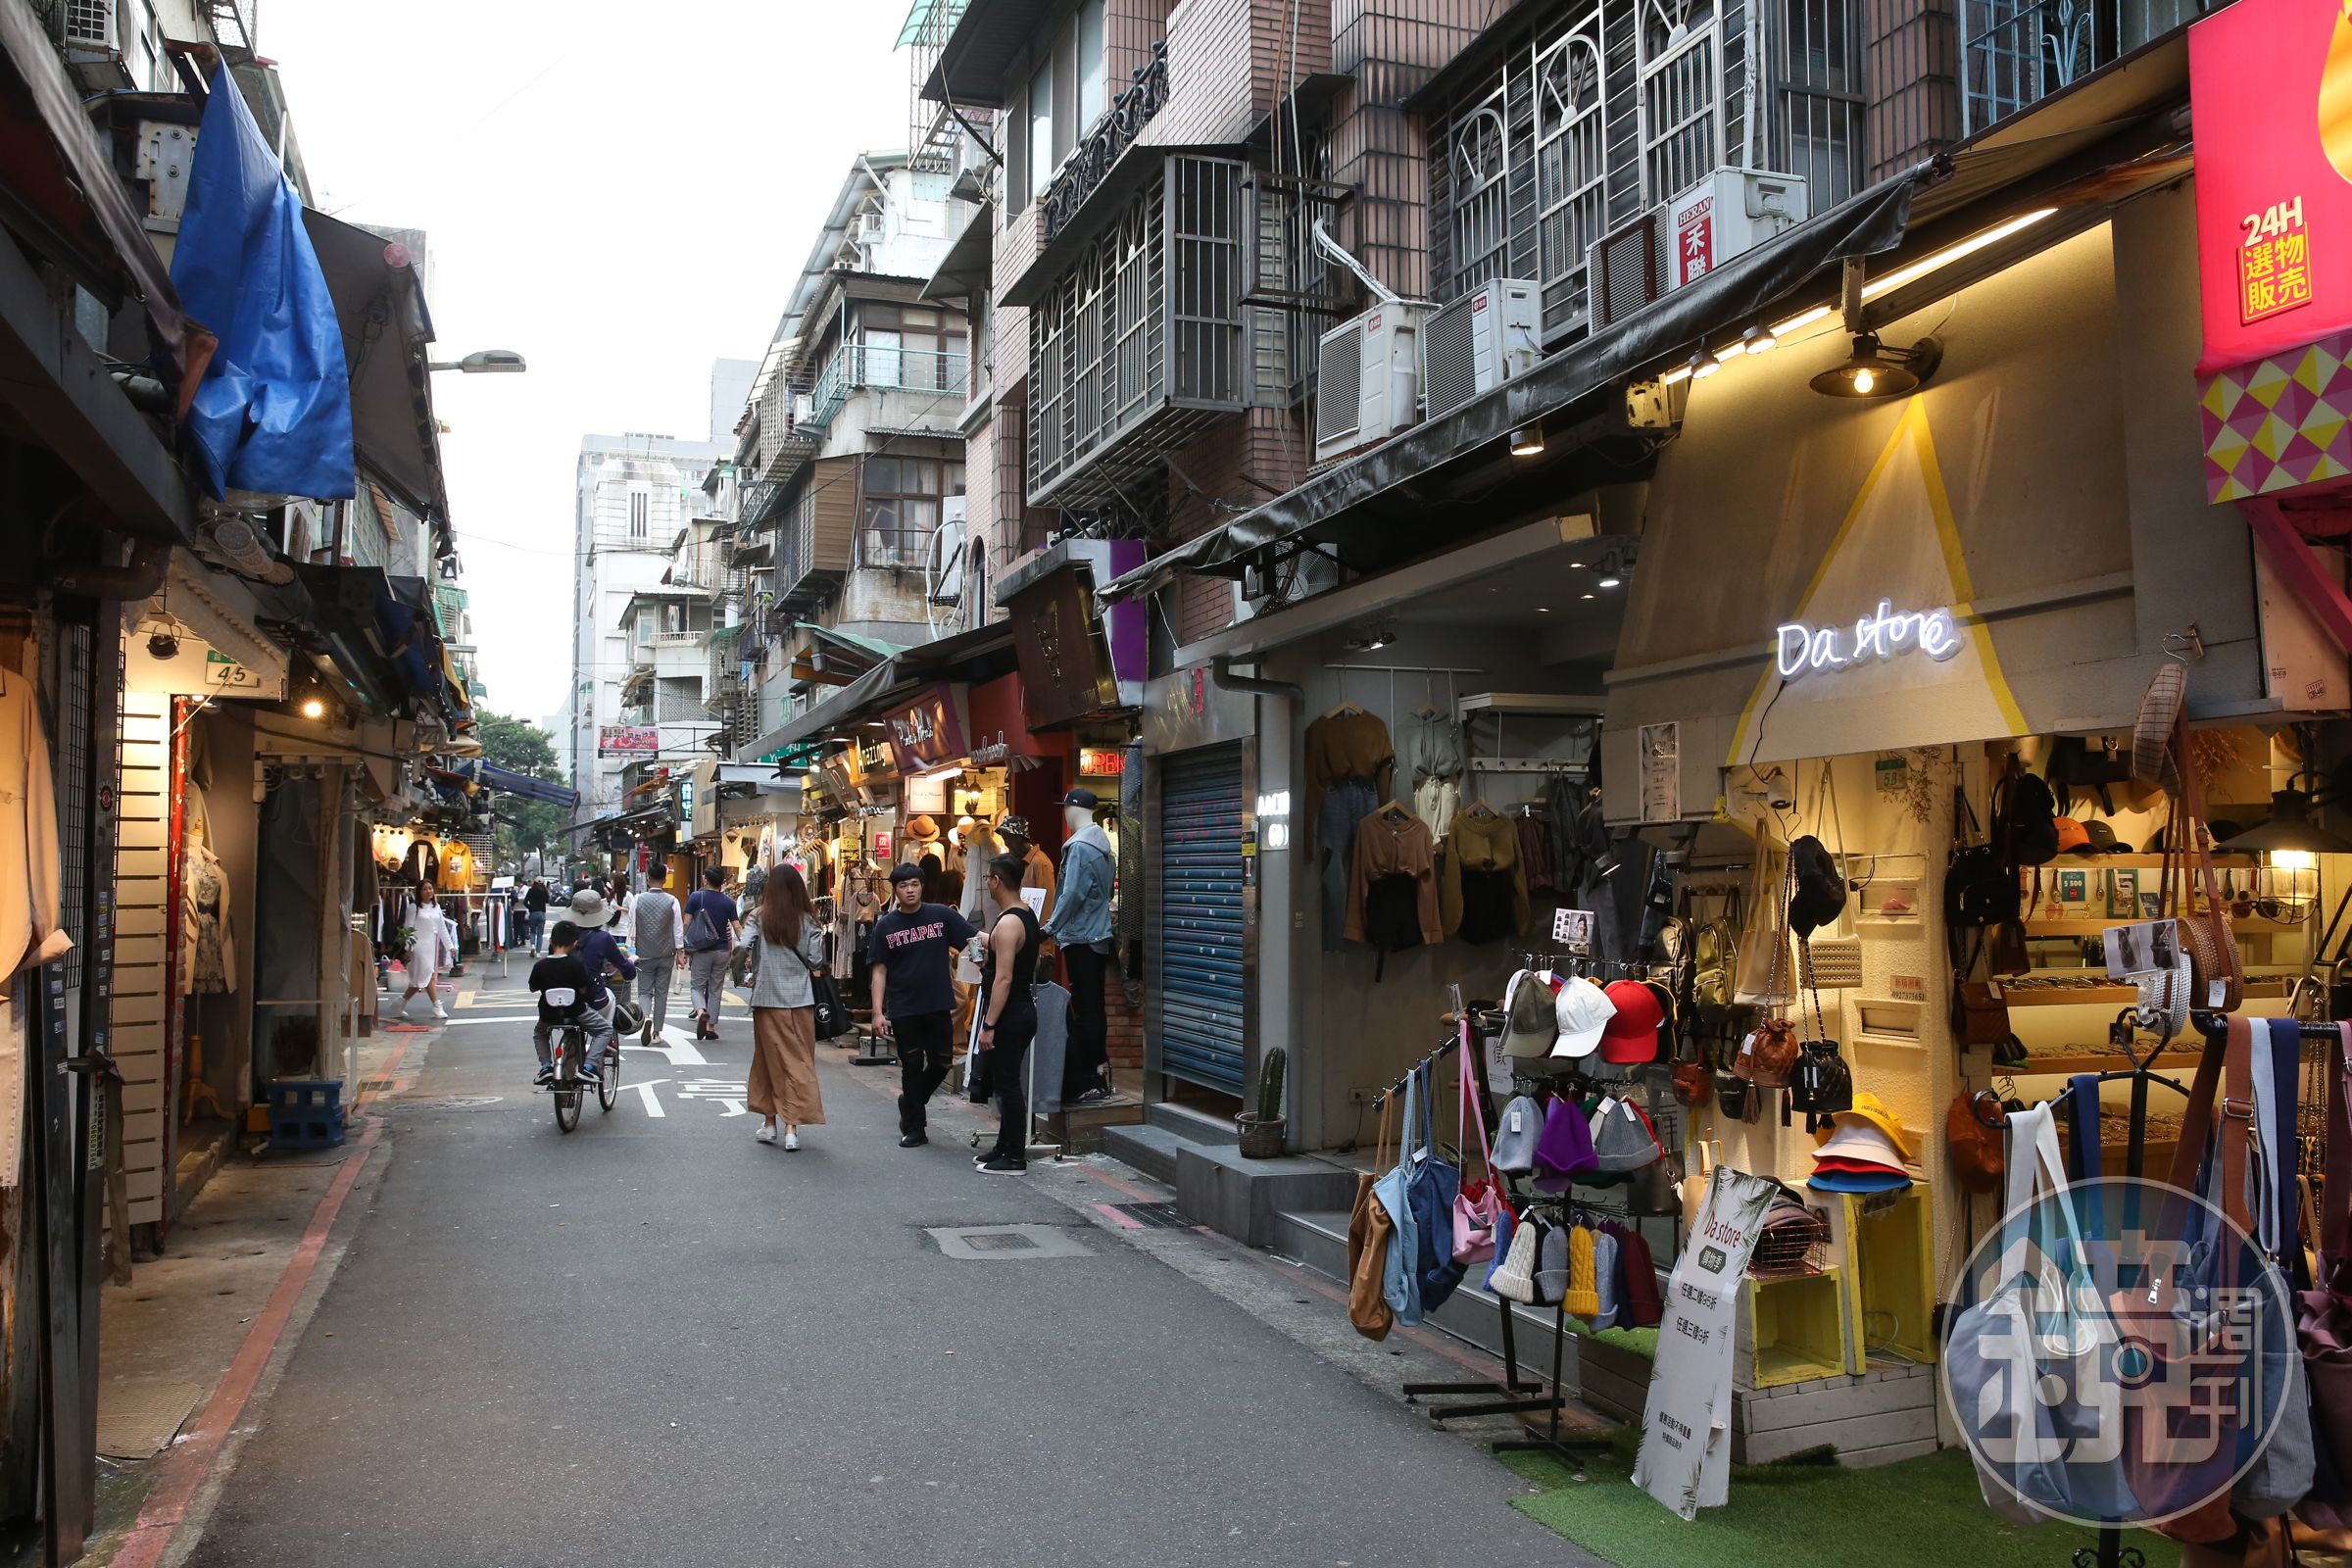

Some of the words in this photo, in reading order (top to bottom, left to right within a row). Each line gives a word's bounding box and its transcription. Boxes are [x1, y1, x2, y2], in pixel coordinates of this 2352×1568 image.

[1679, 198, 1710, 226] HERAN
[2243, 195, 2303, 248] 24H
[2245, 233, 2305, 281] 選物
[2248, 266, 2308, 315] 販売
[1777, 623, 1847, 676] Da
[1853, 602, 1959, 658] store
[218, 665, 246, 683] 45
[1081, 753, 1127, 774] OPEN
[885, 922, 944, 949] PITAPAT
[1704, 1210, 1718, 1239] Da
[1716, 1220, 1741, 1248] store
[1681, 1282, 1718, 1311] 任選二樣95折
[1676, 1316, 1710, 1346] 任選三樣9折
